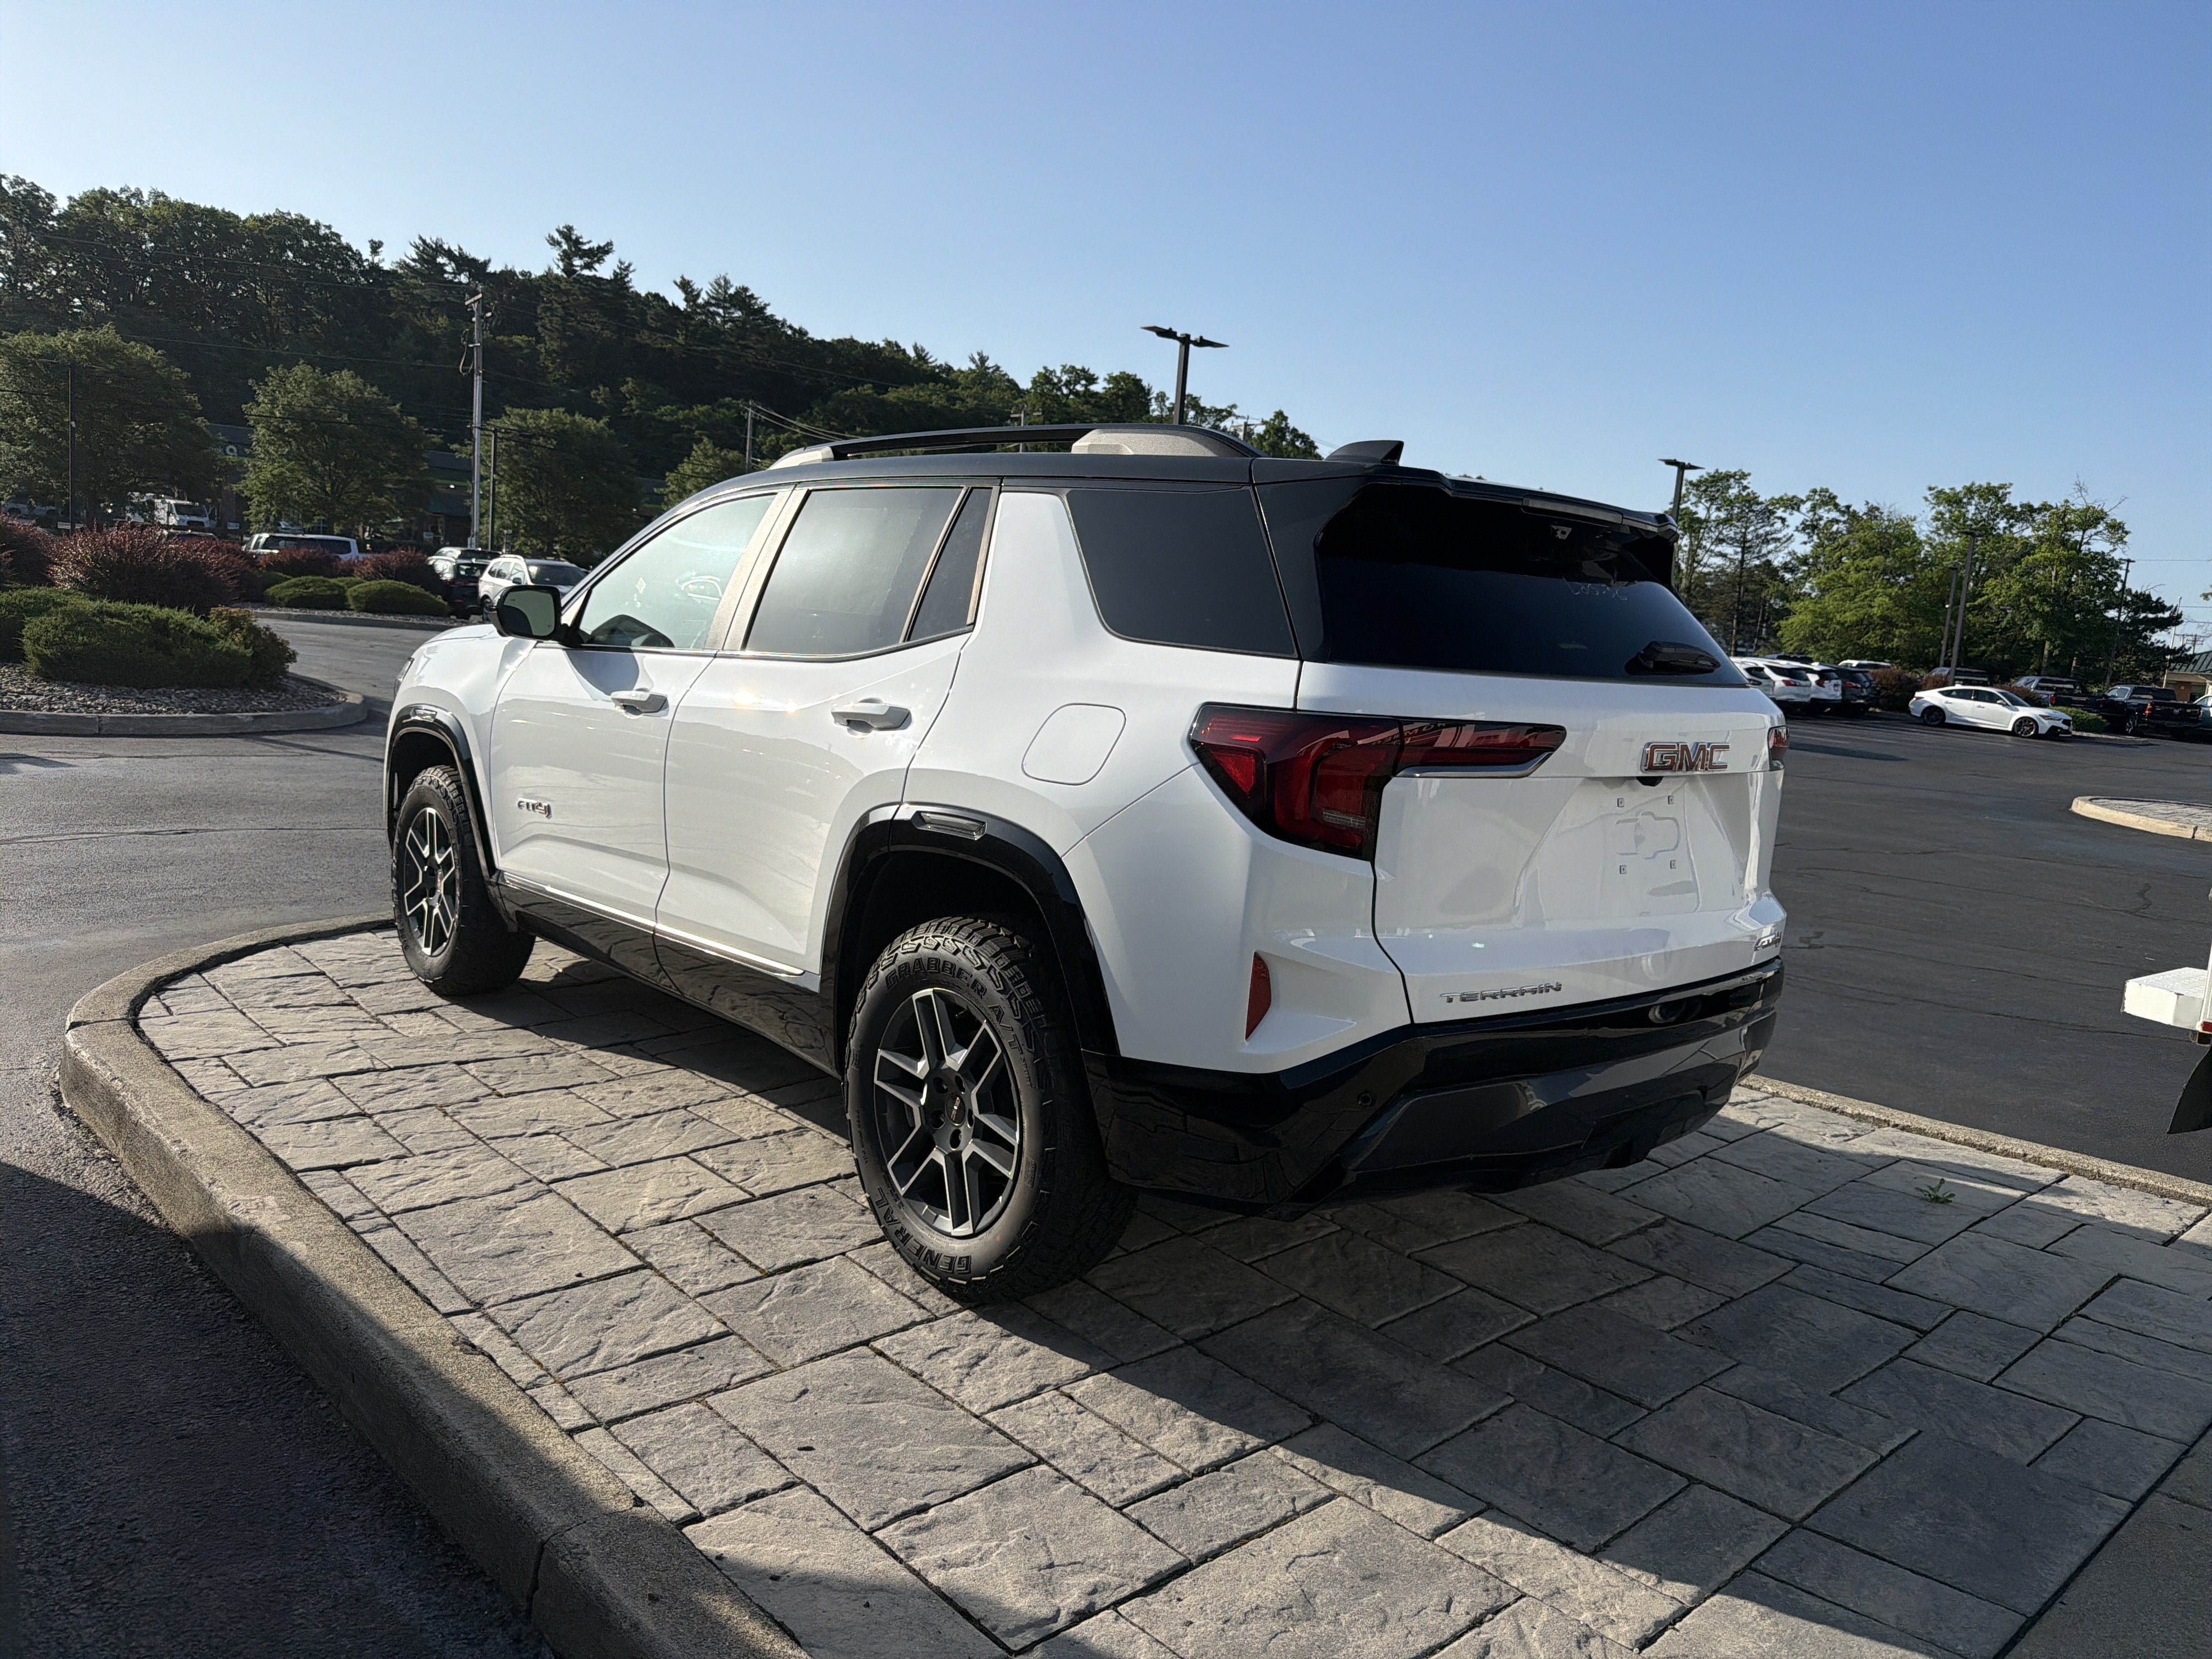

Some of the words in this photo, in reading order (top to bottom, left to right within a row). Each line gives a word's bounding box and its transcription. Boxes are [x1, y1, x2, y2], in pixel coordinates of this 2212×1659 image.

[1640, 741, 1730, 772] GMC
[885, 956, 988, 999] GRABBER
[988, 1004, 1024, 1055] A/T
[1440, 981, 1562, 1003] TERRAIN
[875, 1186, 972, 1274] GENERAL
